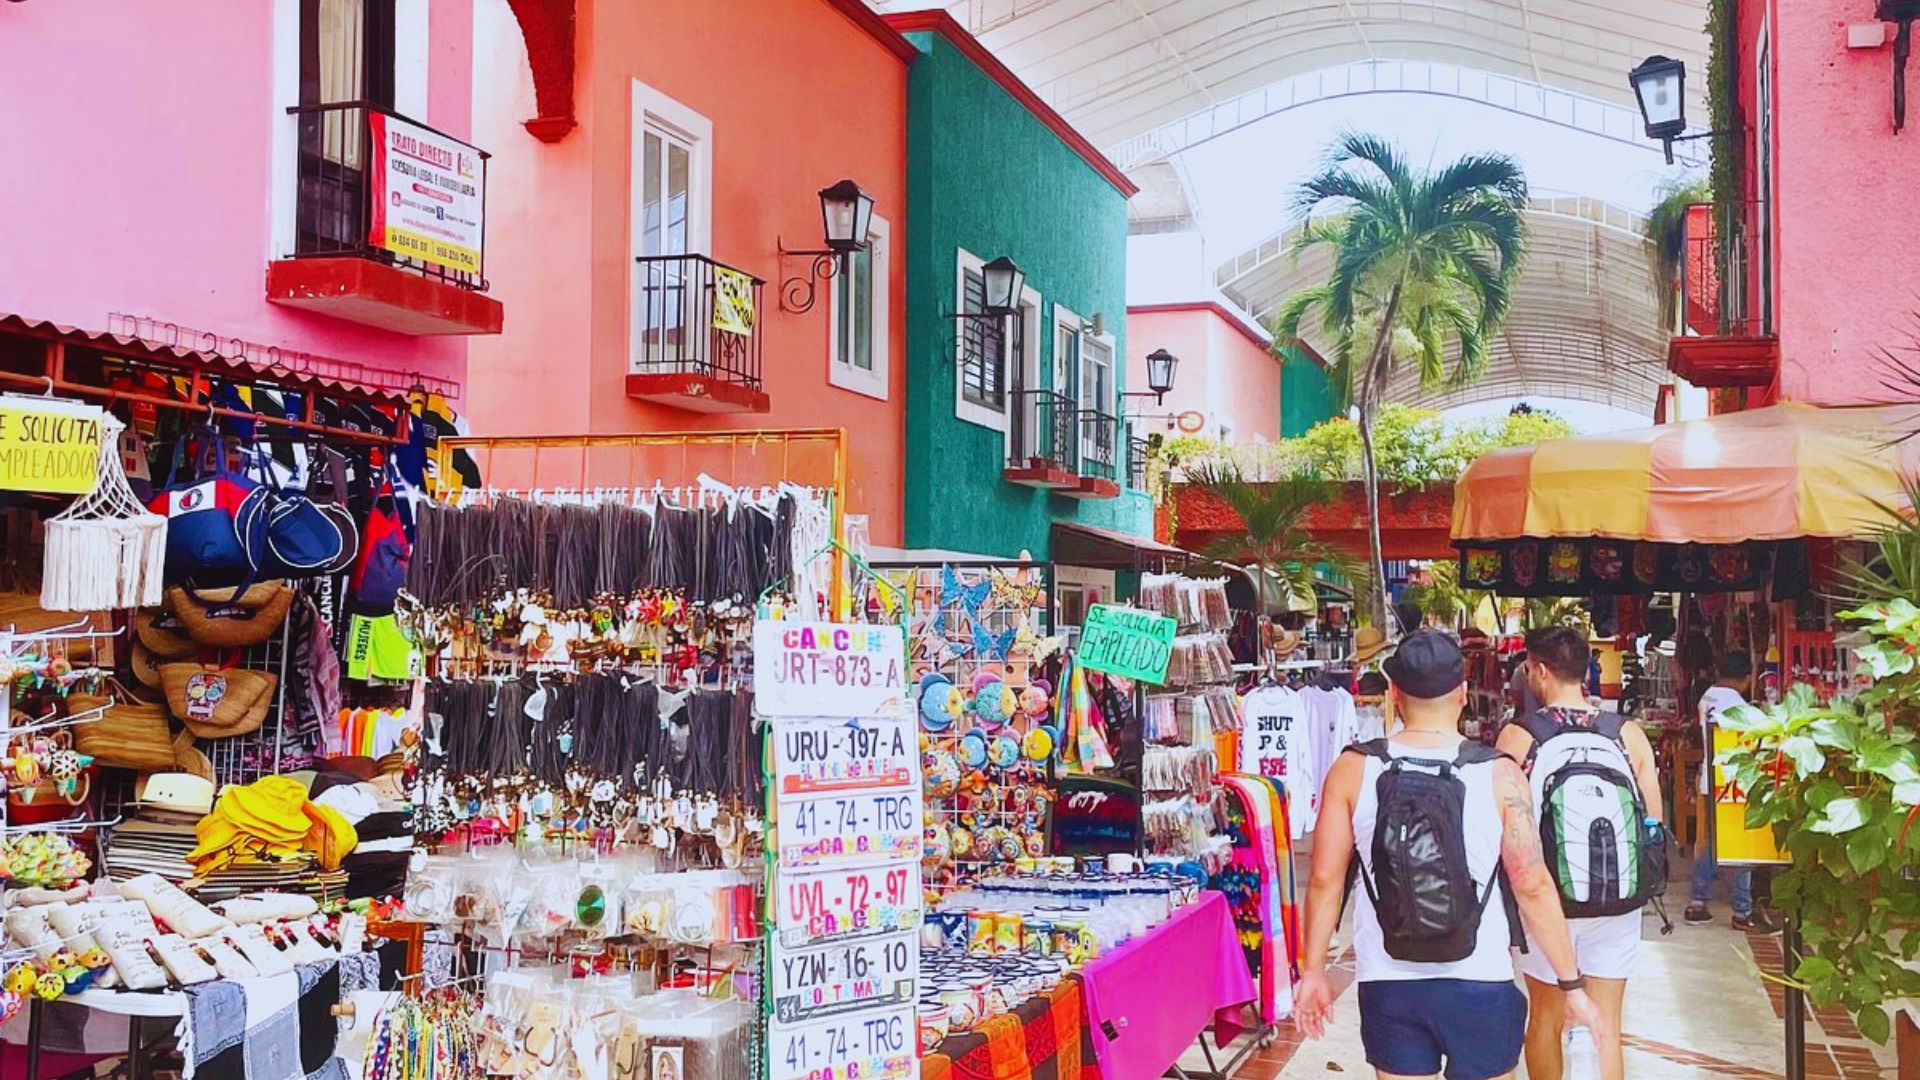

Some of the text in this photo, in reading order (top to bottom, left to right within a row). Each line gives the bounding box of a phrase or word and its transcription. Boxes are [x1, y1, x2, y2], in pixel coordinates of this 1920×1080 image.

[391, 131, 417, 154] TRATO
[419, 141, 453, 167] DIRECTO
[0, 414, 98, 446] E SOLICITA
[0, 448, 98, 481] MPLEADO(A)
[320, 575, 334, 623] CANCU
[1088, 606, 1166, 638] SE SOLICITA
[354, 620, 372, 661] MUJERES
[1080, 626, 1169, 674] EMPLEADO
